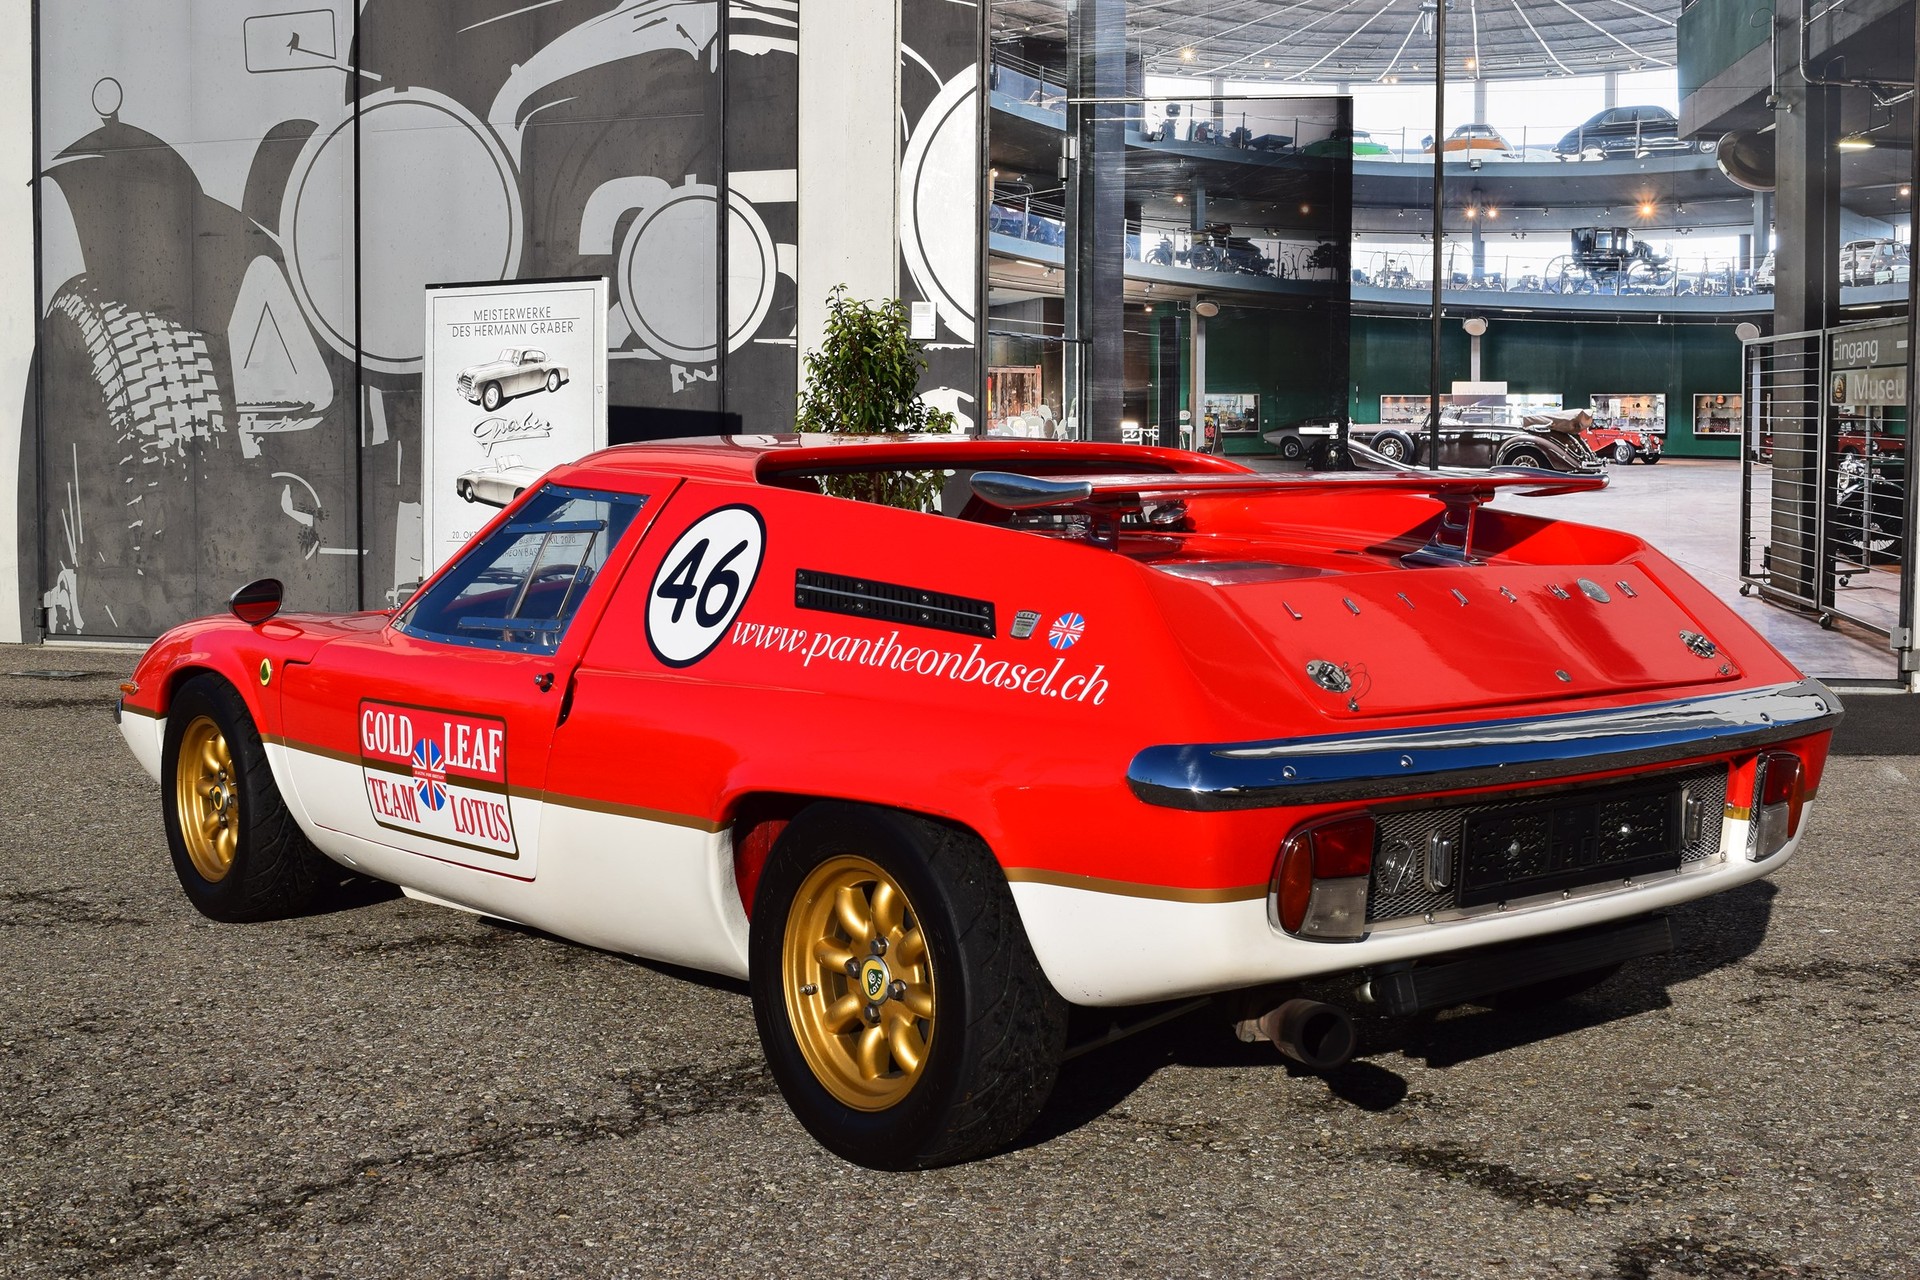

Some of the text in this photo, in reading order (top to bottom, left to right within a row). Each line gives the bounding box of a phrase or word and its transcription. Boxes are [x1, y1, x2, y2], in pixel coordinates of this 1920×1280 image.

[473, 306, 551, 321] MEISTERWERKE
[452, 321, 574, 337] DES HERMANN GRABER
[1833, 338, 1879, 366] Eingang
[452, 530, 462, 539] 20.
[656, 537, 749, 629] 46
[731, 619, 1110, 706] www.pantheonbasel.ch
[362, 709, 503, 774] GOLD LEAF
[367, 776, 510, 844] TEAM LOTUS
[870, 973, 883, 995] LOTUS
